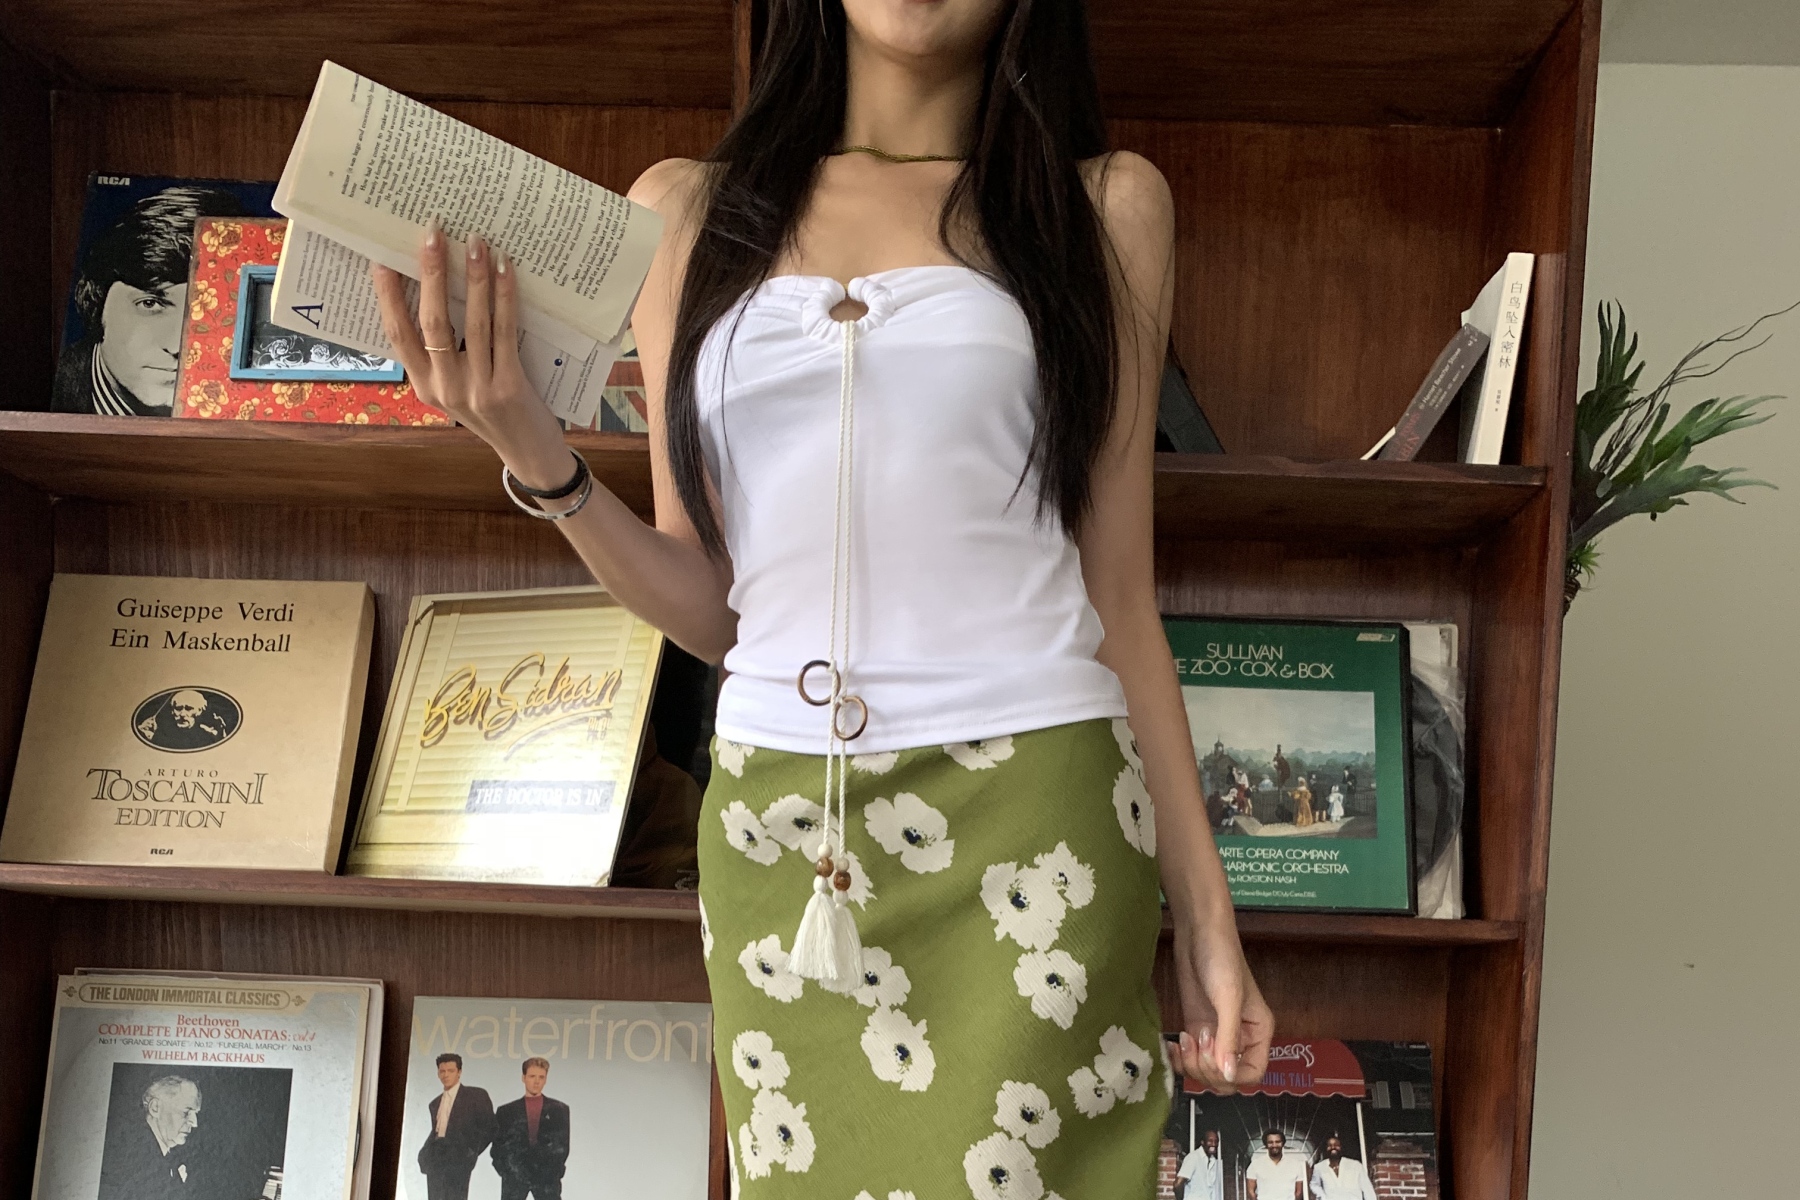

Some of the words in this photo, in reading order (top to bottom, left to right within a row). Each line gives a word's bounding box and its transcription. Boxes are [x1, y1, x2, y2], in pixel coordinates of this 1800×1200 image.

[98, 176, 130, 186] RCA
[291, 302, 324, 329] A
[117, 598, 224, 625] Guiseppe
[237, 601, 295, 624] Verdi
[110, 628, 150, 649] Ein
[162, 630, 291, 653] Maskenball
[1206, 643, 1283, 661] SULLIVAN
[1190, 659, 1231, 676] ZOO
[1240, 661, 1278, 677] COX
[1280, 664, 1296, 678] &
[1298, 663, 1335, 679] BOX
[421, 664, 491, 746] Ben
[484, 652, 624, 741] Sidran
[144, 768, 218, 778] ARTURO
[87, 767, 269, 805] TOSCANINI
[475, 788, 503, 804] THE
[567, 788, 581, 805] IS
[586, 788, 604, 806] IN
[114, 808, 226, 829] EDITION
[150, 847, 174, 856] RCA
[1219, 847, 1244, 858] ARTE
[1246, 848, 1284, 859] OPERA
[1285, 849, 1339, 860] COMPANY
[1224, 861, 1280, 873] HARMONIC
[1282, 862, 1349, 874] ORCHESTRA
[1275, 876, 1297, 884] NASH
[90, 986, 111, 1001] THE
[113, 987, 160, 1002] LONDON
[161, 989, 223, 1004] IMMORTAL
[225, 991, 281, 1006] CLASSICS
[177, 1014, 239, 1027] Beethoven
[98, 1023, 171, 1037] COMPLETE
[175, 1026, 221, 1039] PIANO
[224, 1028, 291, 1041] SONATAS:
[413, 1004, 712, 1063] waterfront
[142, 1050, 198, 1061] WILHELM
[202, 1052, 265, 1063] BACKHAUS
